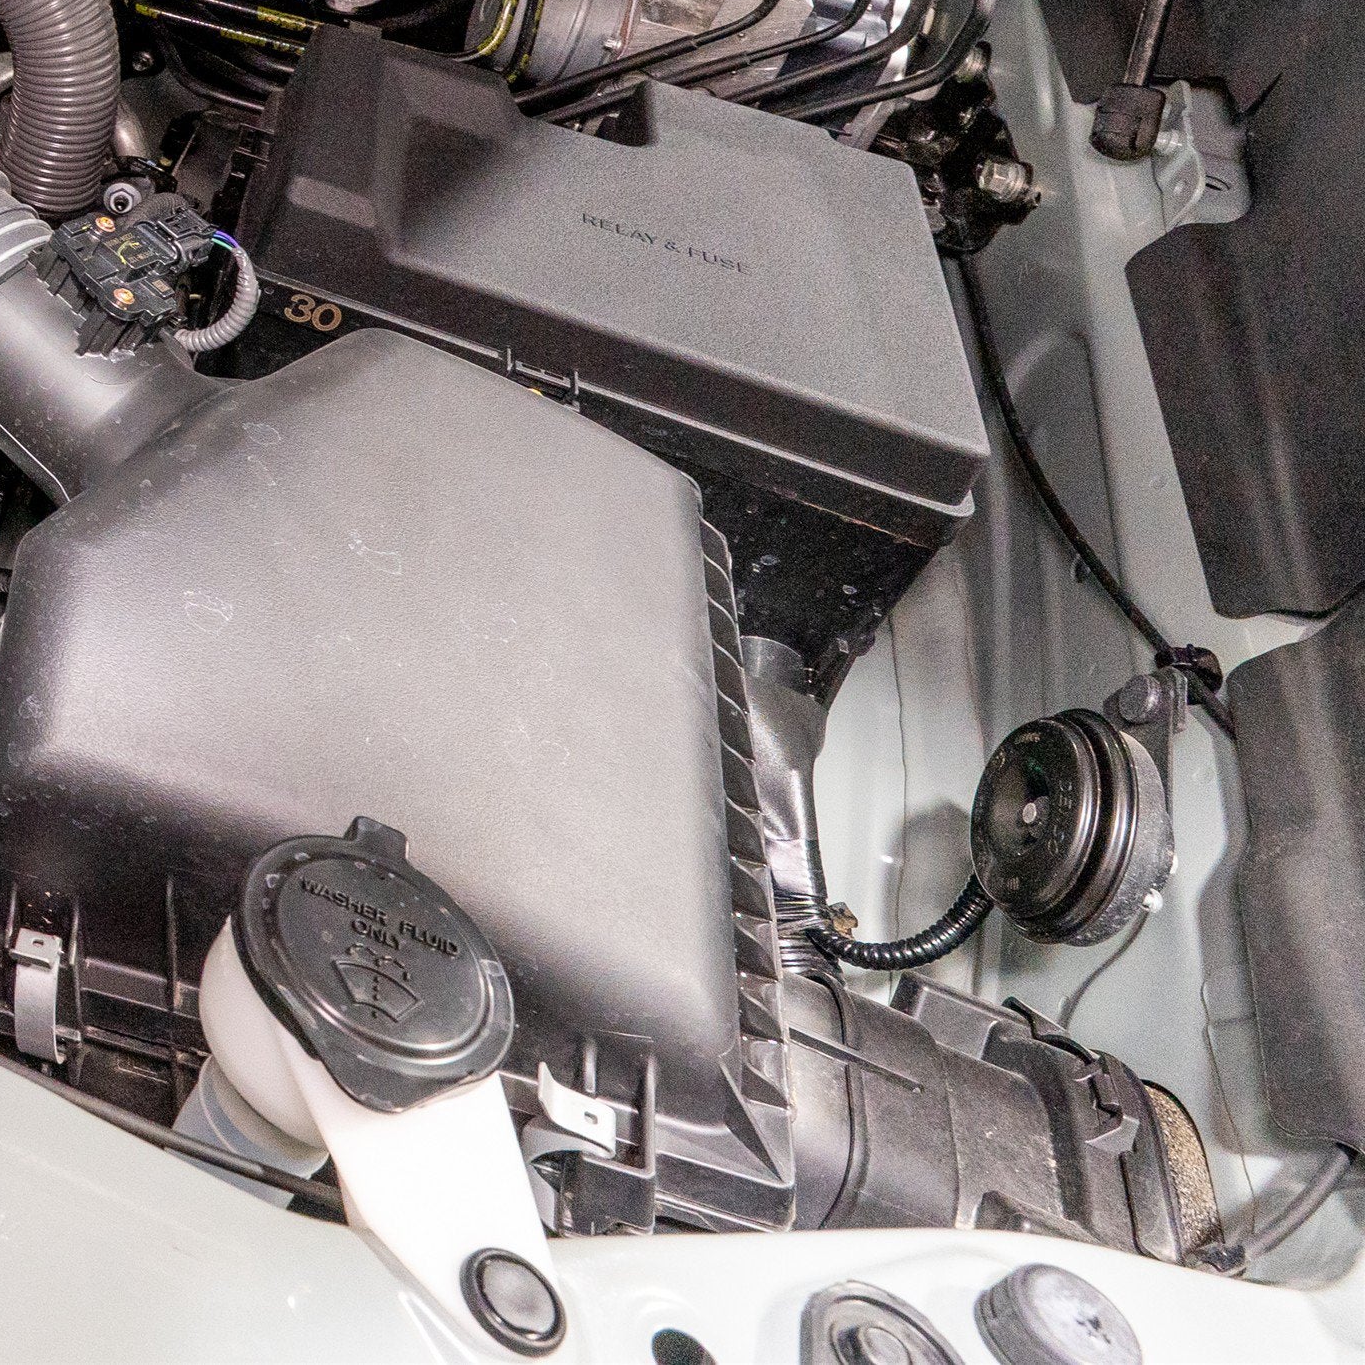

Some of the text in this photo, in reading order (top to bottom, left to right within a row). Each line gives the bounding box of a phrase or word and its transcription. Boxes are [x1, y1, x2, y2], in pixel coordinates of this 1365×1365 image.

[582, 213, 657, 245] RELAY
[688, 247, 752, 275] FUSE
[284, 294, 342, 332] 30
[300, 877, 460, 958] WASHER FLUID
[351, 918, 401, 951] ONLY
